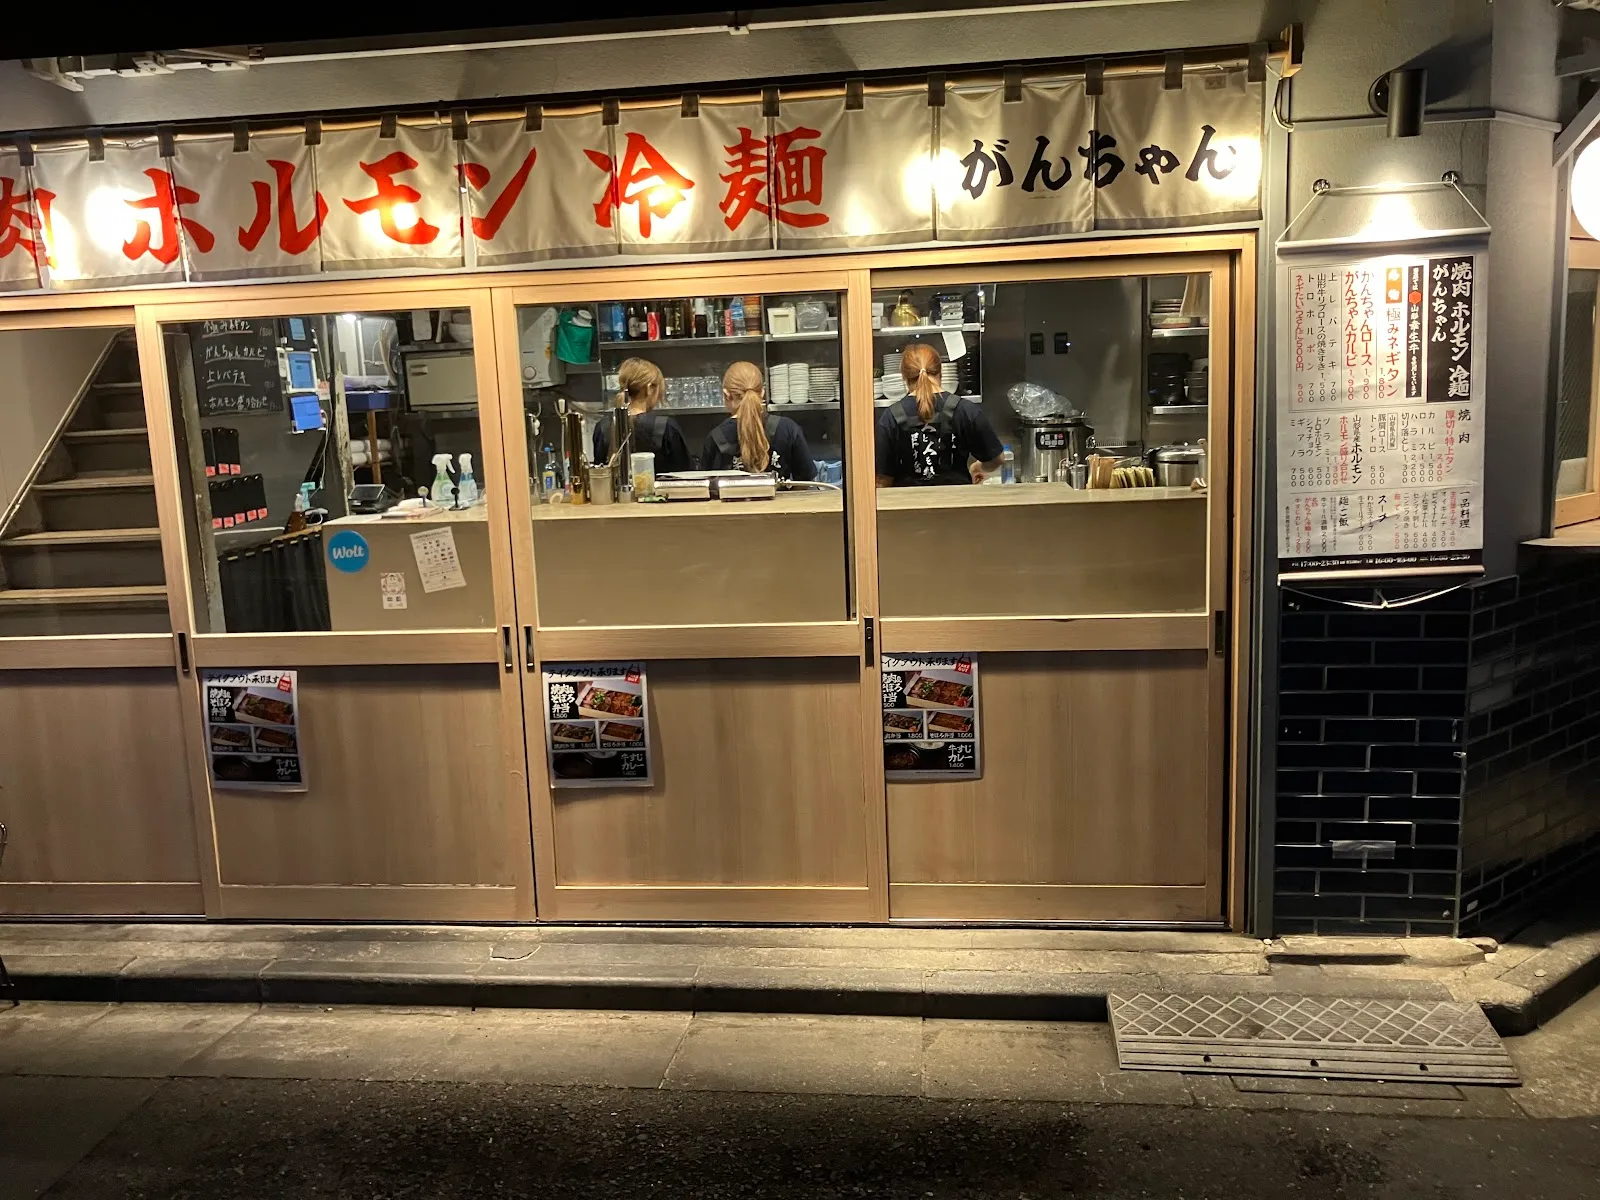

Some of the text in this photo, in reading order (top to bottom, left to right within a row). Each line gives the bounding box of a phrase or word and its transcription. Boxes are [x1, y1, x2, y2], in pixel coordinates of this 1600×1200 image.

[122, 147, 537, 264] ホルモン
[582, 126, 829, 237] 冷麺
[958, 124, 1237, 201] がんちゃん
[1328, 272, 1337, 369] 上レバテキ
[1344, 271, 1359, 367] がんちゃんカルビ
[1431, 264, 1449, 342] がんちゃん
[1448, 262, 1472, 397] 焼肉 ホルモン 冷麺
[1290, 419, 1296, 457] ミノ
[1297, 418, 1305, 457] ギアラ
[1306, 418, 1314, 457] シマチョウ
[1314, 416, 1322, 457] トロホルモン
[1401, 412, 1409, 453] 切り落とし
[1444, 409, 1456, 473] 厚切り特上タン
[1458, 408, 1471, 444] 焼肉
[1378, 495, 1387, 523] スープ
[333, 545, 364, 560] Wolt
[948, 754, 974, 762] カレー
